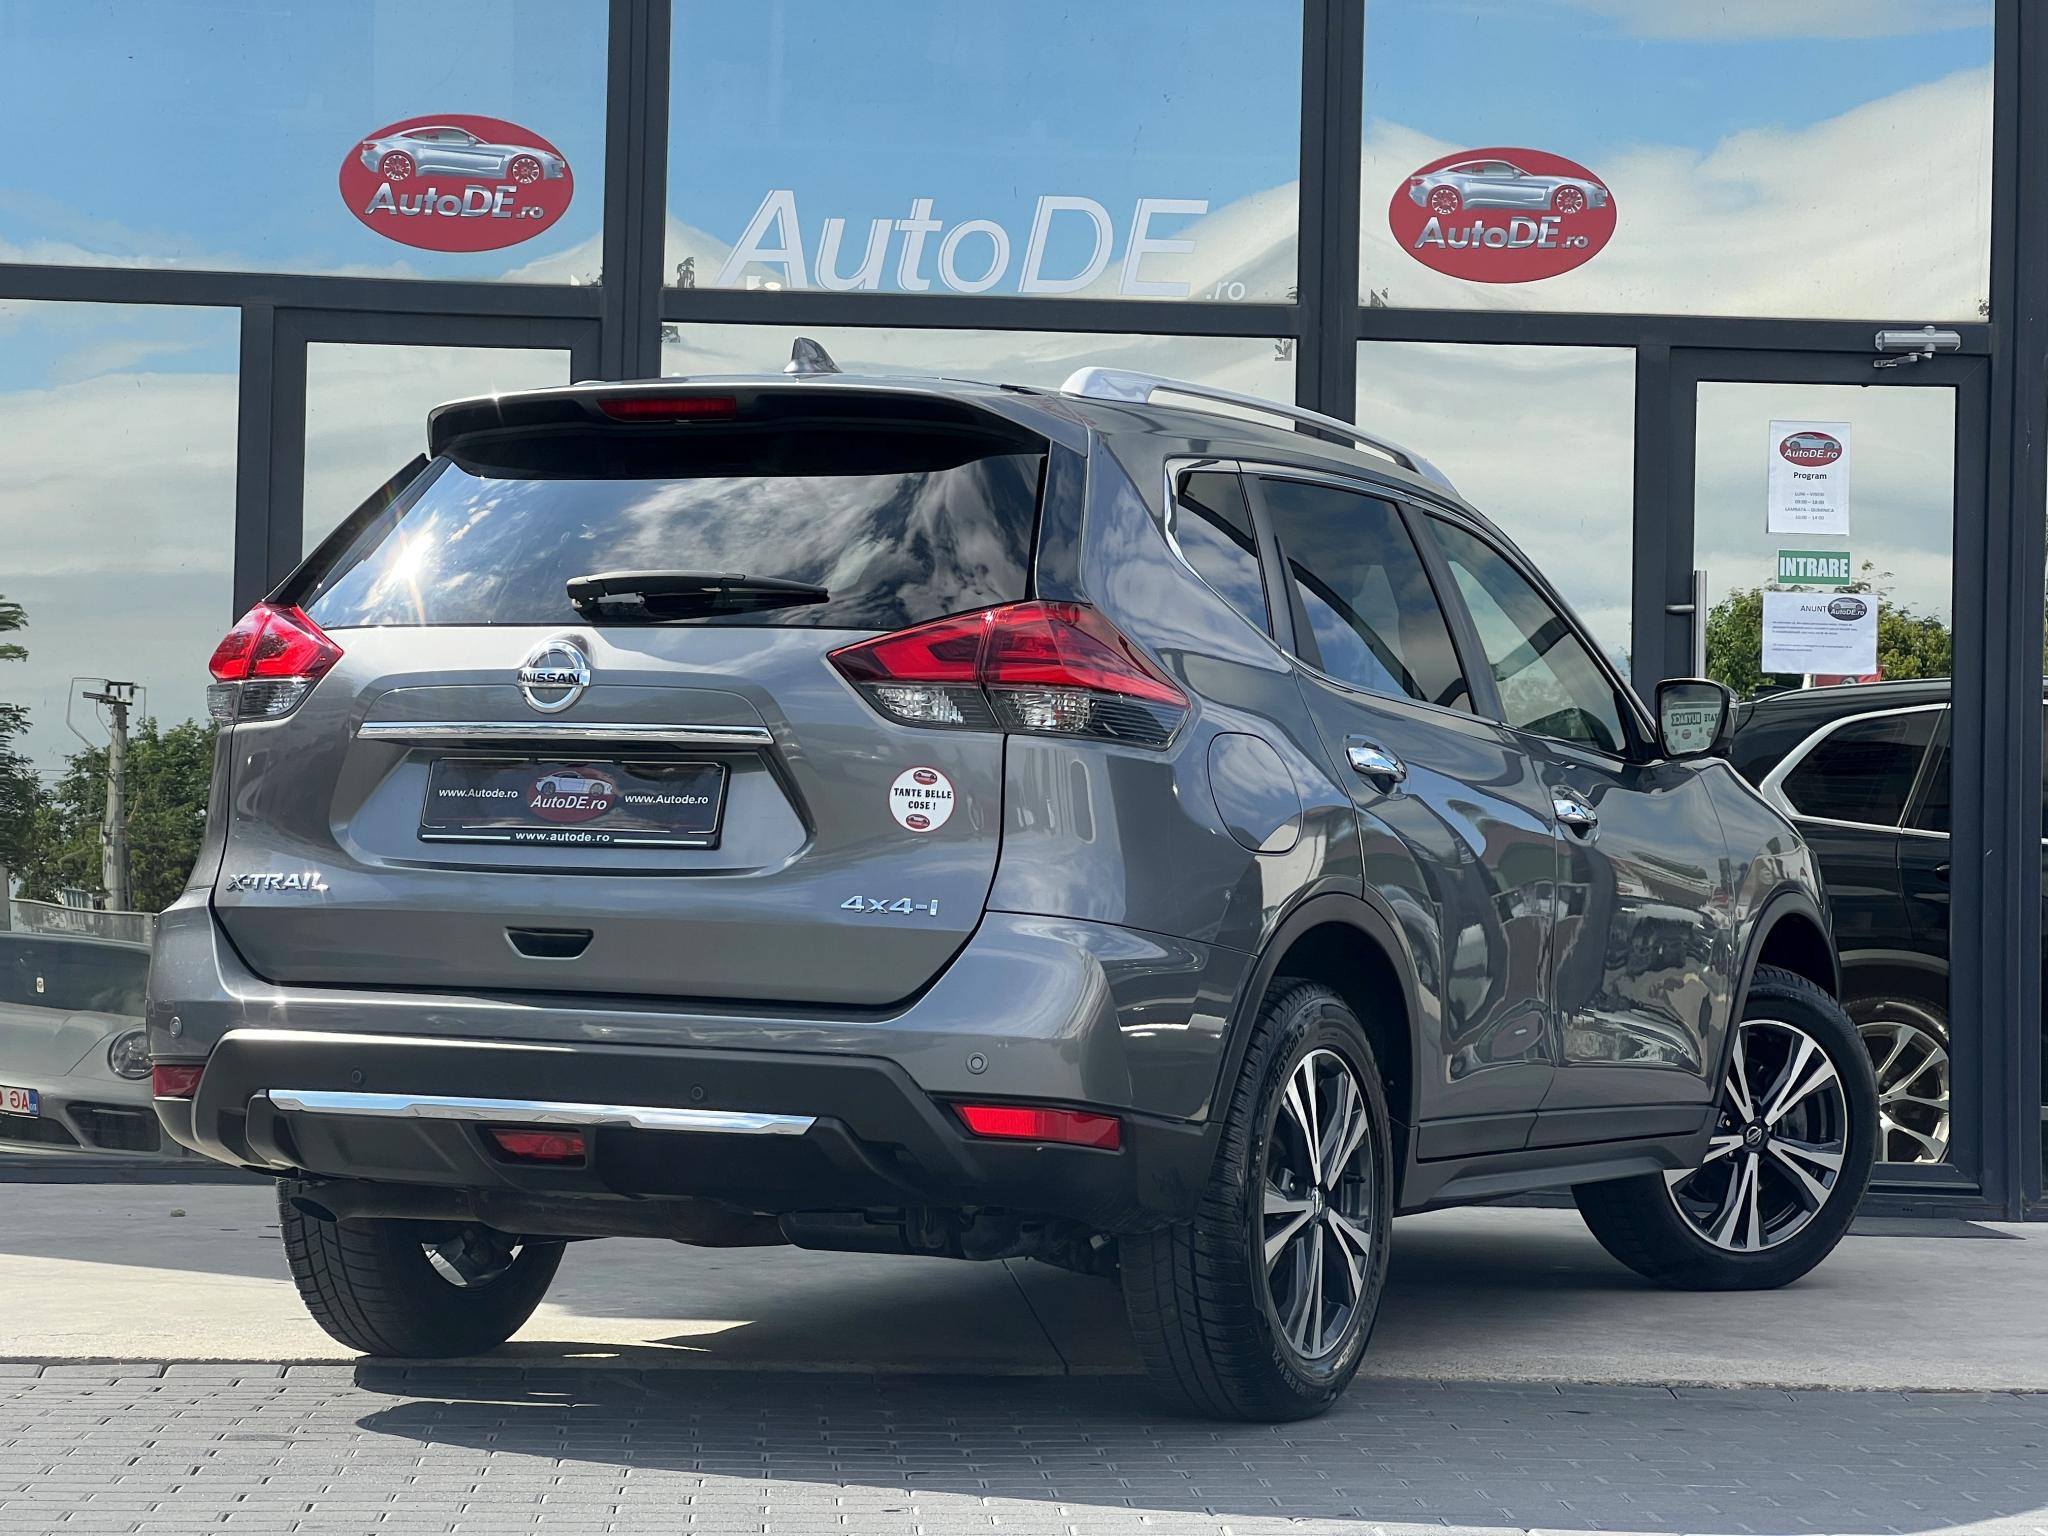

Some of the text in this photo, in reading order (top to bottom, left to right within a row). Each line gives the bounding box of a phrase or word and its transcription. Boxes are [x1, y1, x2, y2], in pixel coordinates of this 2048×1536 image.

[1784, 448, 1838, 459] AutoDE.ro
[1793, 472, 1827, 481] Program
[1779, 557, 1848, 577] INTRARE
[522, 672, 580, 683] NISSAN
[439, 787, 518, 799] www.Autode.ro
[624, 793, 709, 805] www.Autode.ro
[893, 788, 952, 799] TANTE BELLE
[530, 794, 607, 811] AutoDE.ro
[908, 801, 930, 809] COSE
[515, 830, 610, 843] www.autode.ro
[226, 873, 329, 892] X-TRAIL
